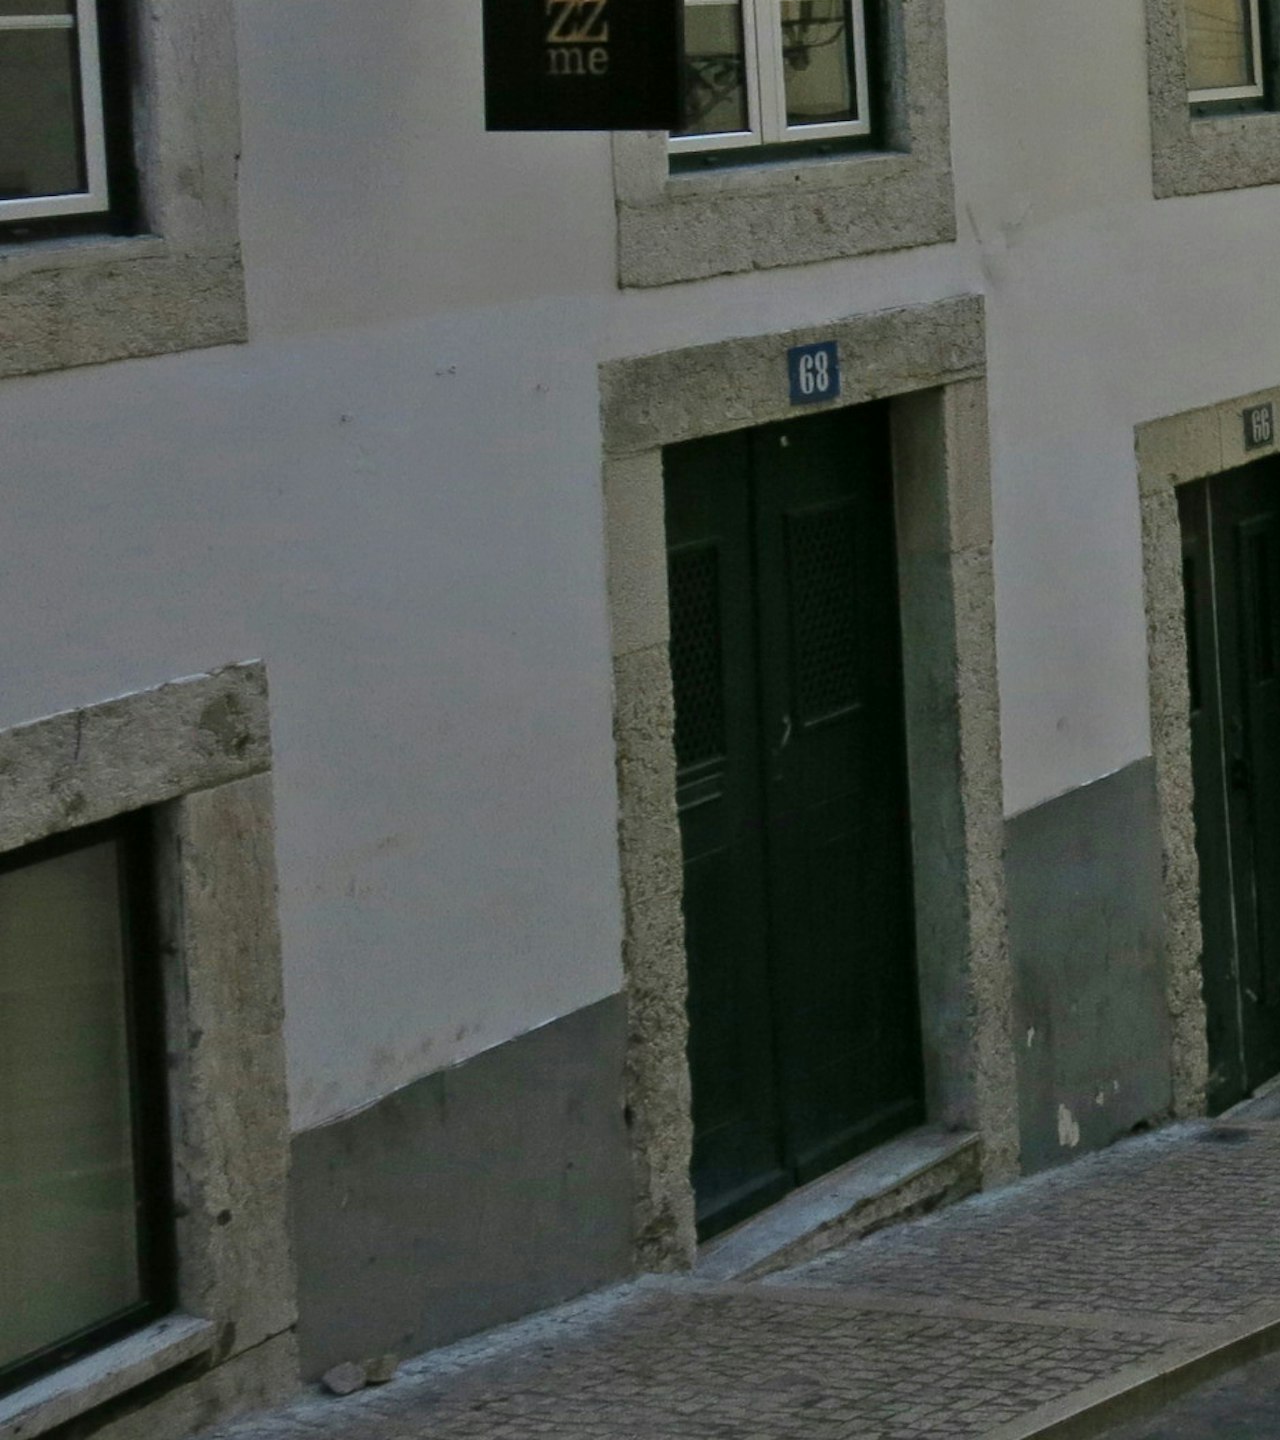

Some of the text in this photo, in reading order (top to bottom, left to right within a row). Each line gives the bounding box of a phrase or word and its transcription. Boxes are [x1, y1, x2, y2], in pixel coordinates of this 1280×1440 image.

[547, 47, 610, 76] me
[799, 350, 830, 395] 68
[1251, 407, 1271, 443] 66
